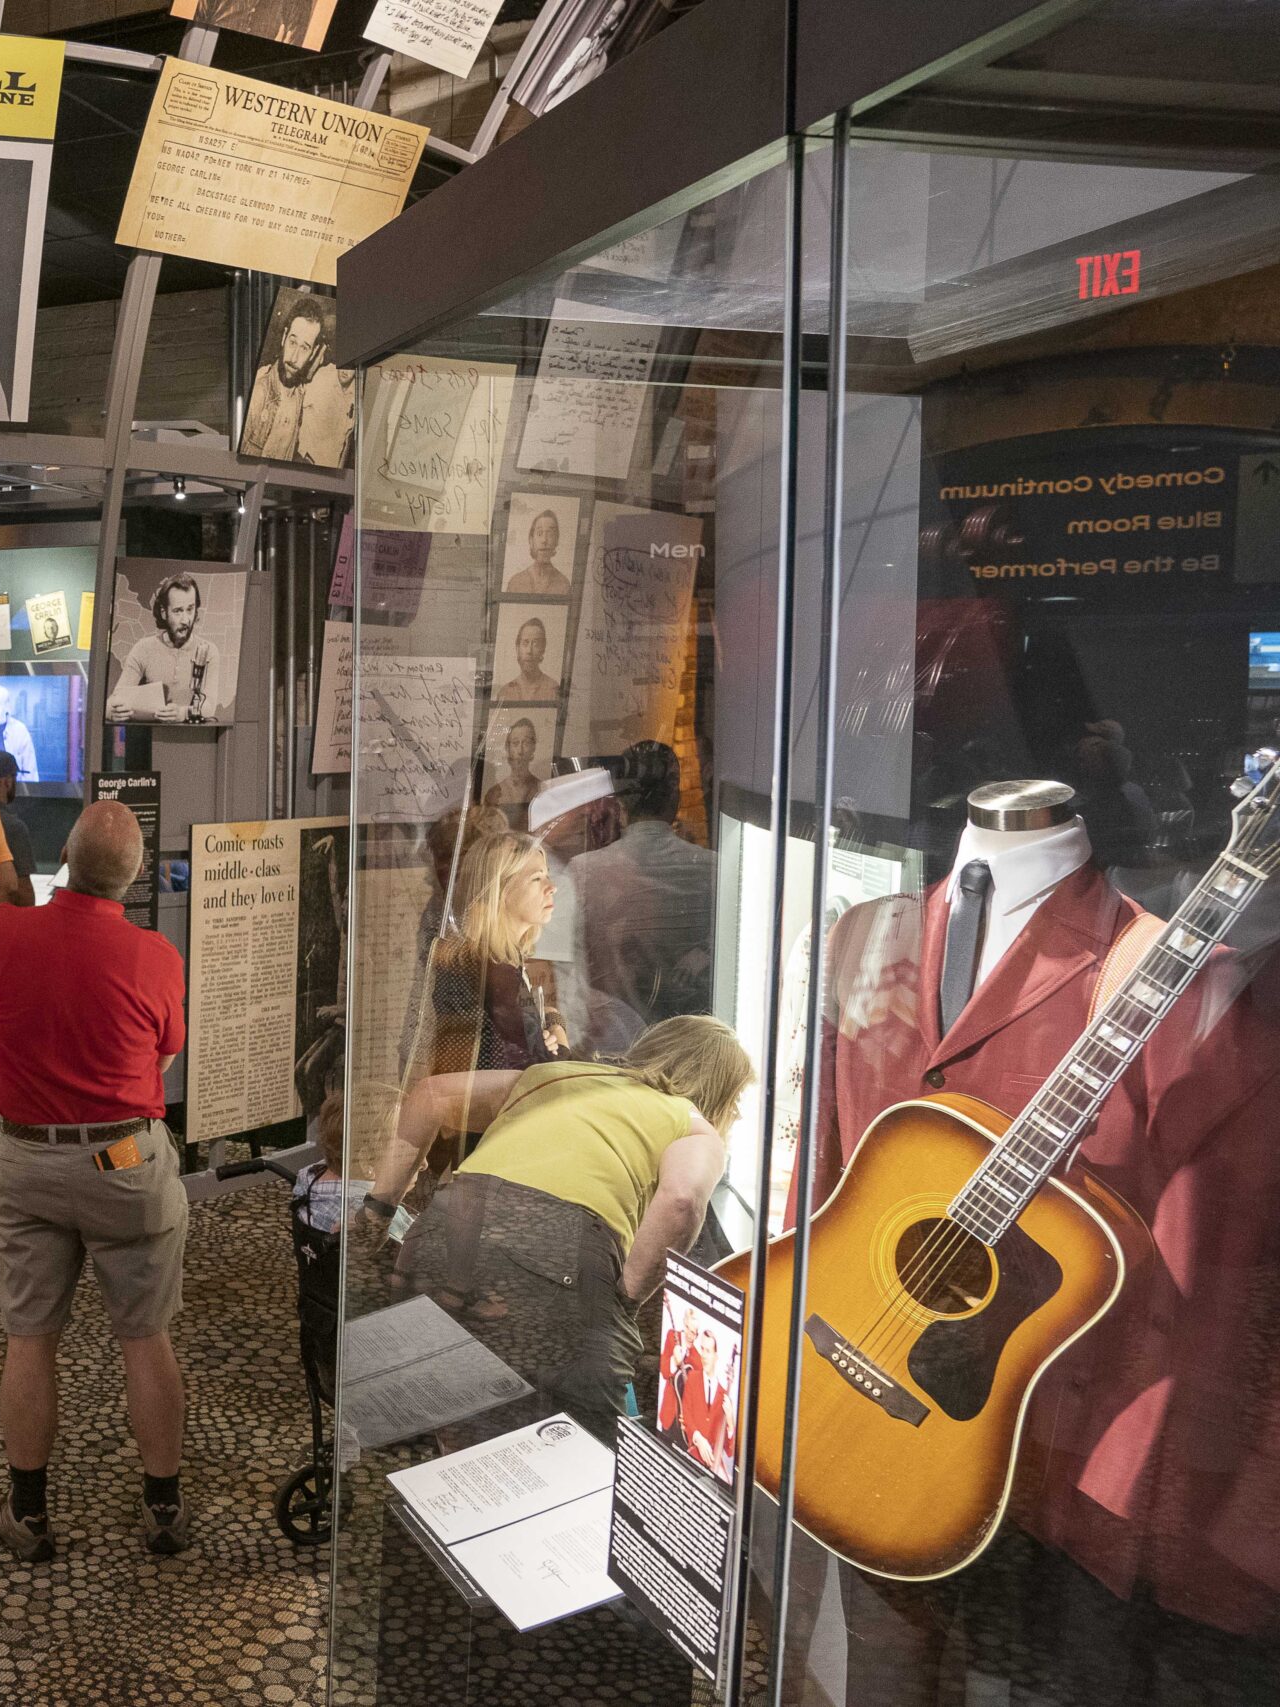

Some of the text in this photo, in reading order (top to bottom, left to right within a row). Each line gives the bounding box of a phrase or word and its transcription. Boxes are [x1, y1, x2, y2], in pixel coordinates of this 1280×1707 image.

[225, 85, 317, 126] WESTERN
[321, 111, 384, 143] UNION
[271, 121, 328, 146] TELEGRAM
[157, 161, 186, 175] GEORGE
[235, 162, 252, 174] YORK
[196, 187, 237, 204] BACKSTAGE
[278, 206, 308, 220] THEATRE
[177, 201, 191, 212] ALL
[195, 205, 231, 220] CHEERING
[234, 213, 248, 223] FOR
[251, 217, 265, 227] YOU
[650, 543, 706, 558] Men
[30, 598, 63, 613] GEORGE
[34, 607, 62, 621] CARLIN
[98, 777, 157, 790] George Carlin's
[98, 791, 119, 800] Stuff
[204, 834, 284, 853] Comic roasts
[203, 884, 295, 910] and they love it
